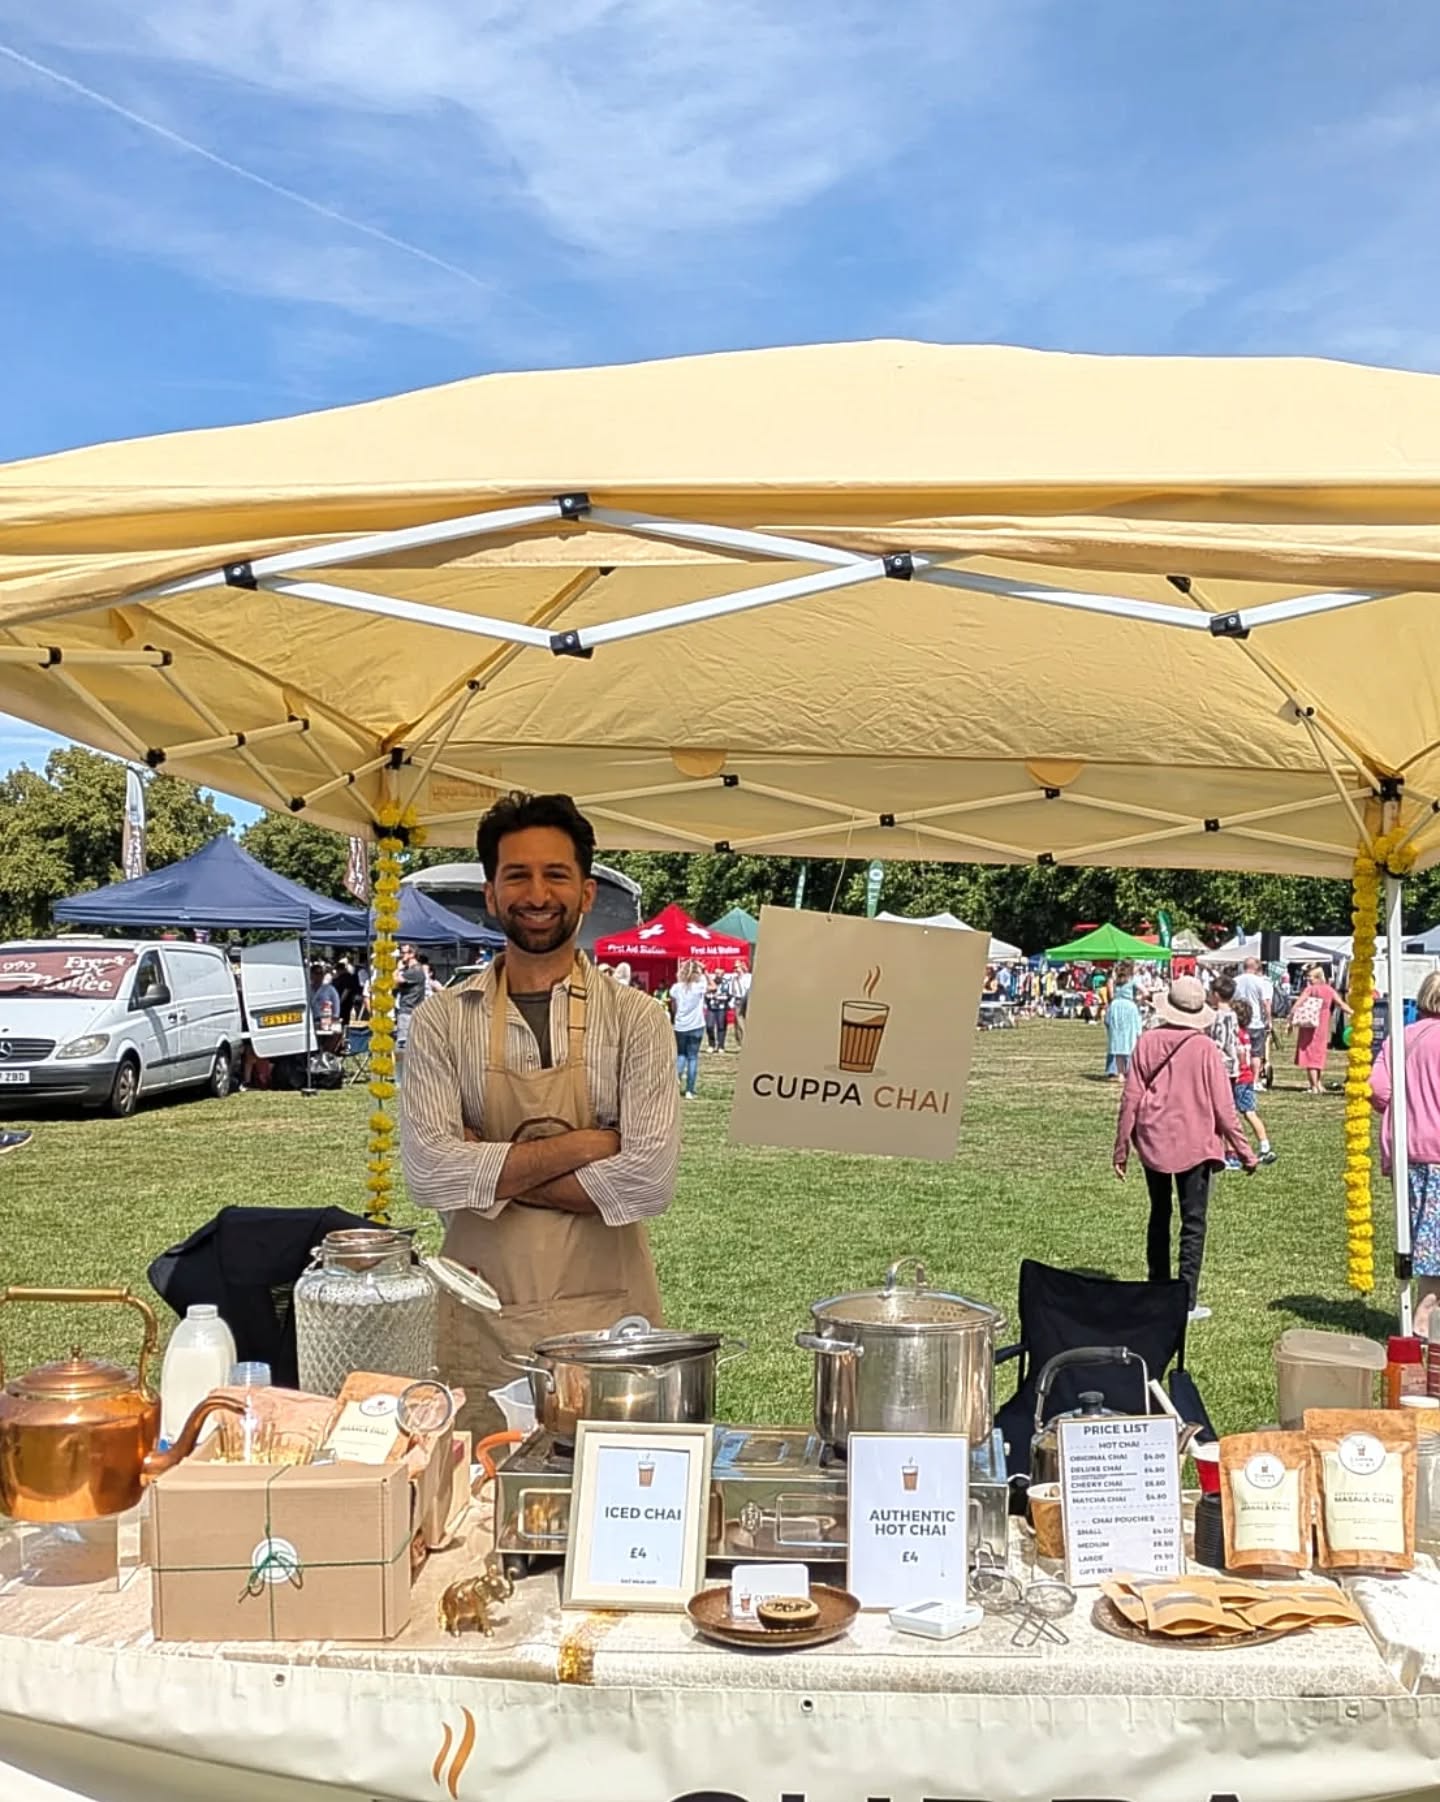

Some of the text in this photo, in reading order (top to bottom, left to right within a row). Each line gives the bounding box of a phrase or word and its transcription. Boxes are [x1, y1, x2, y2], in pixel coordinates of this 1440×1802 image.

[752, 1073, 950, 1114] CUPPA CHAI
[1083, 1423, 1149, 1436] PRICE LIST
[1099, 1440, 1140, 1449] HOT CHAI
[1108, 1453, 1128, 1461] CHAI
[1070, 1466, 1101, 1474] DELUXE
[1102, 1465, 1122, 1473] CHAI
[1070, 1481, 1102, 1489] CHEEKY
[1103, 1480, 1123, 1488] CHAI
[1072, 1496, 1106, 1505] MATCHA
[605, 1506, 682, 1521] ICED CHAI
[869, 1509, 956, 1522] AUTHENTIC
[1092, 1515, 1155, 1525] CHAI POUCHES
[875, 1523, 947, 1536] HOT CHAI
[630, 1547, 647, 1559] £4
[902, 1551, 918, 1563] £4
[1078, 1554, 1104, 1562] LARGE
[1079, 1567, 1097, 1576] GIFT
[1097, 1566, 1113, 1575] BOX
